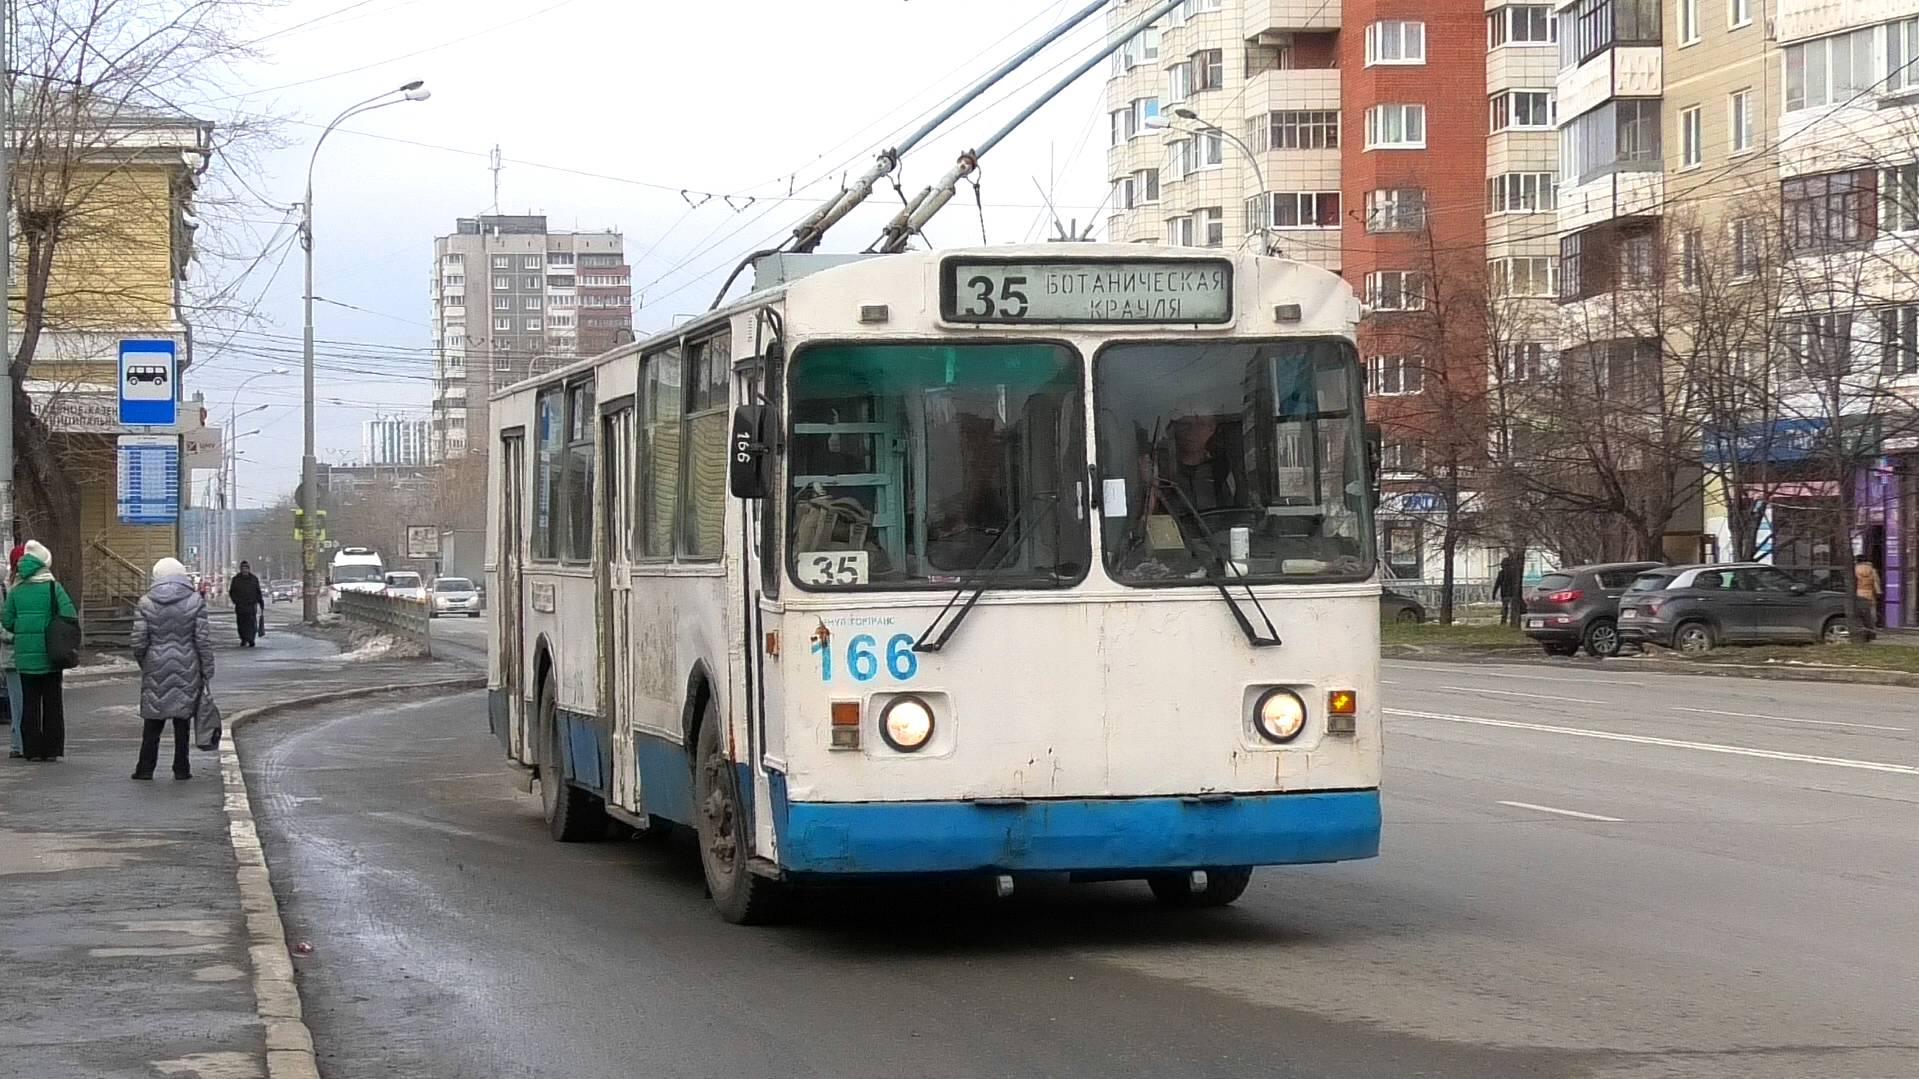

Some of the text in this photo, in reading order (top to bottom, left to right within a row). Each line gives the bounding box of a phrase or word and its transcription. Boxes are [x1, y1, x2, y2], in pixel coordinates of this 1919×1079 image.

[965, 275, 1029, 319] 35
[1047, 271, 1224, 295] БОТАНИЧЕСКАЯ
[1089, 298, 1182, 319] КРАУЛЯ
[736, 431, 751, 463] 166
[812, 556, 858, 585] 35
[810, 633, 919, 682] 166
